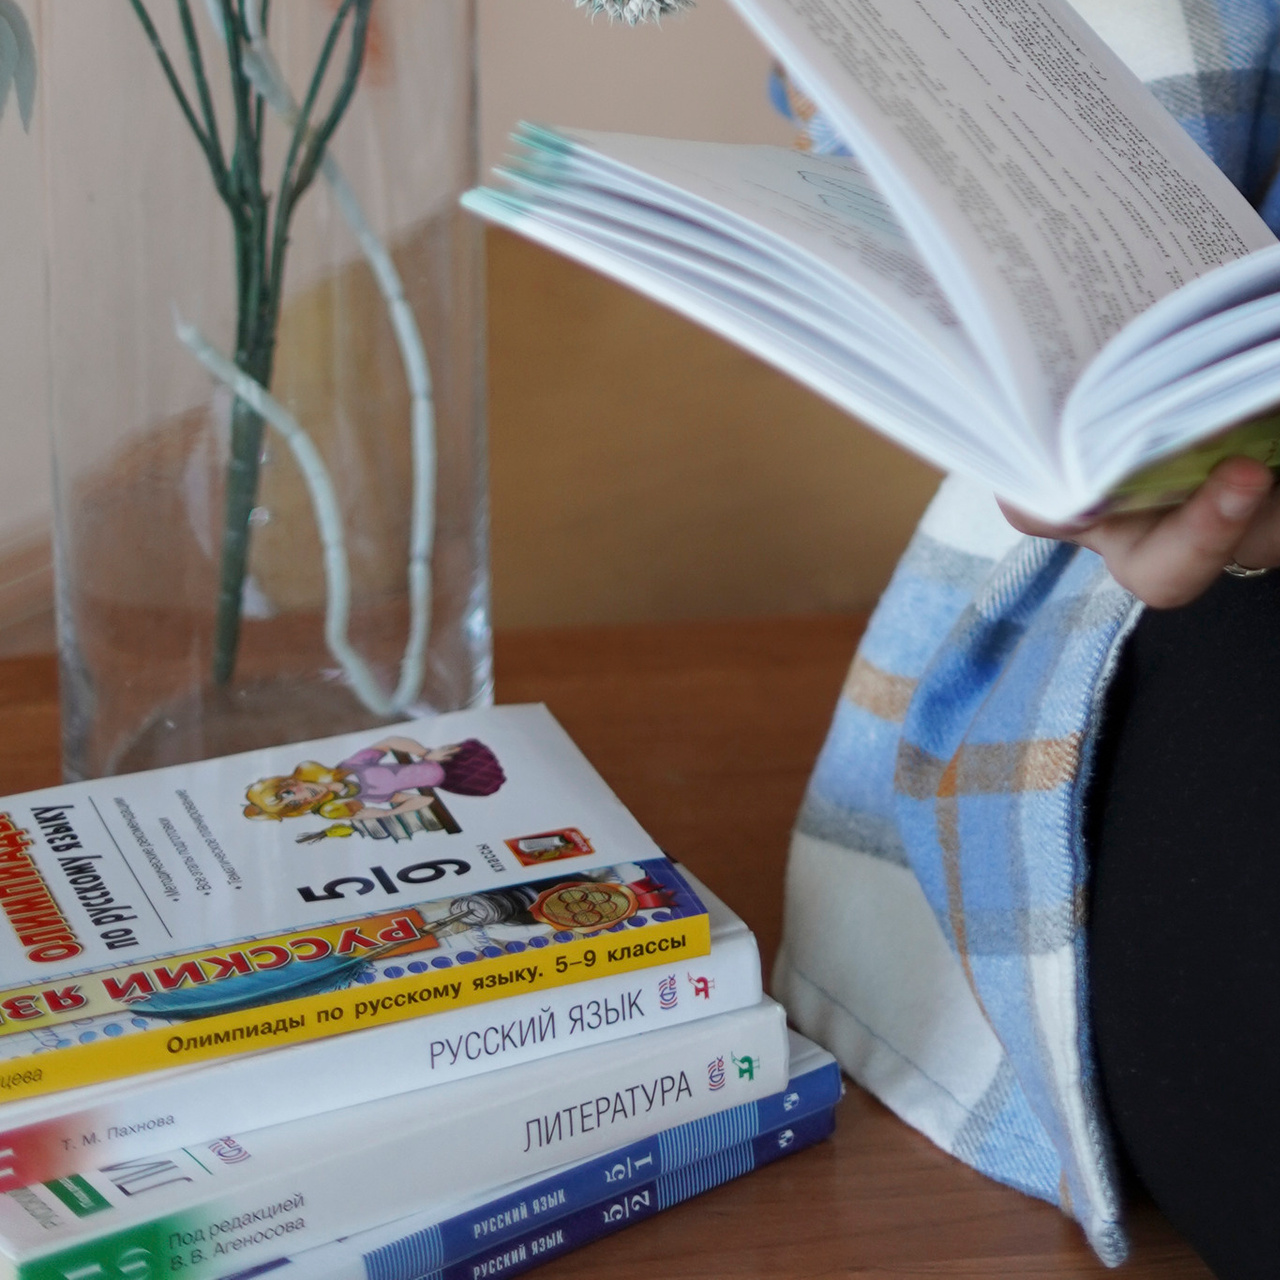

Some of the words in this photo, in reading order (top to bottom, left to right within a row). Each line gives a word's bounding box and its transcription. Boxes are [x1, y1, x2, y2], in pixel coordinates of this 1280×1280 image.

[30, 804, 84, 854] языку
[57, 854, 139, 927] русскому
[100, 926, 140, 951] по
[101, 916, 421, 1004] РУССКИЙ
[166, 1013, 306, 1054] Олимпиады
[316, 1006, 344, 1023] по
[354, 980, 462, 1017] русскому
[471, 963, 544, 992] языку.
[606, 934, 688, 963] классы
[429, 1005, 557, 1070] РУССКИЙ
[568, 988, 646, 1036] ЯЗЫК
[82, 1132, 101, 1146] М.
[106, 1114, 176, 1139] Пахнова
[523, 1070, 693, 1153] ЛИТЕРАТУРА
[168, 1229, 207, 1250] Под
[207, 1191, 306, 1245] редакцией
[211, 1216, 306, 1259] Агеносова
[472, 1202, 529, 1240] РУССКИЙ
[531, 1187, 567, 1214] ЯЗЫК
[472, 1243, 528, 1280] РУССКИЙ
[530, 1228, 565, 1255] ЯЗЫК
